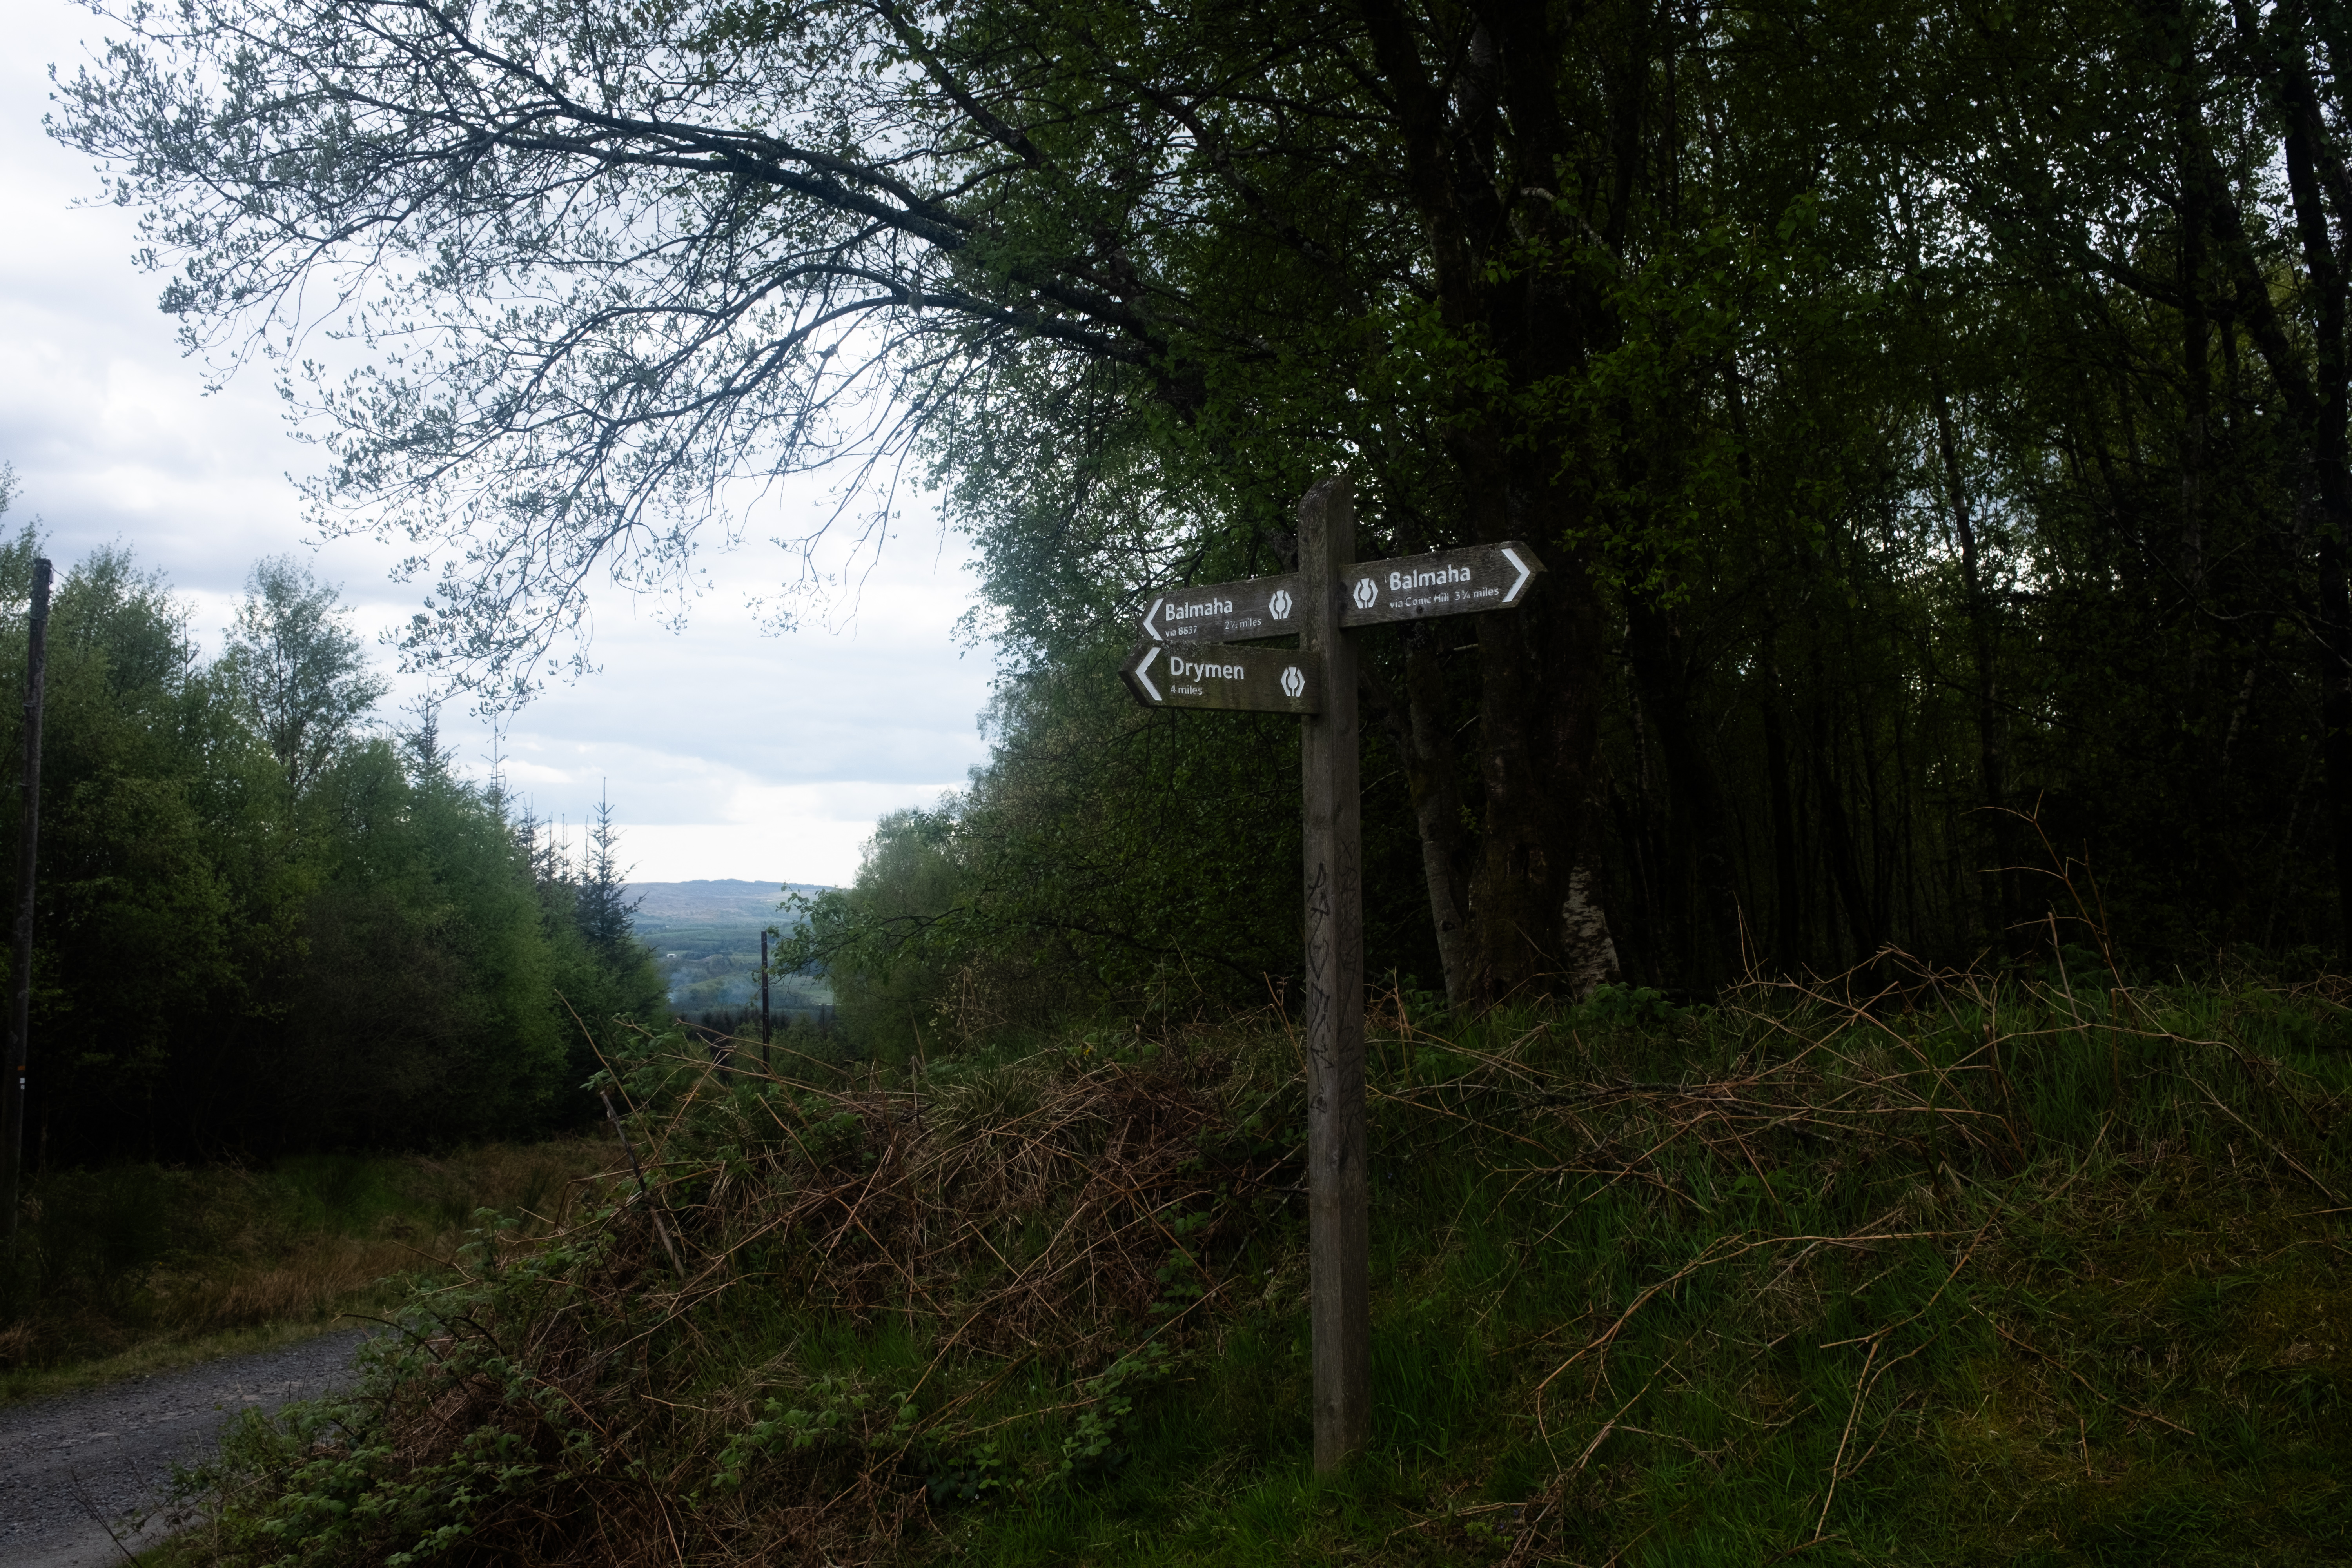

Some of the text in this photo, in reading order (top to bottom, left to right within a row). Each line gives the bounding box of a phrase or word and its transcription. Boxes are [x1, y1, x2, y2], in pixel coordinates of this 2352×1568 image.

[1390, 564, 1471, 591] Balmaha
[1389, 599, 1403, 608] via
[1405, 596, 1432, 606] Conic
[1434, 592, 1449, 603] Hill
[1473, 586, 1499, 598] miles
[1165, 597, 1232, 621] Balmaha
[1165, 628, 1177, 637] via
[1240, 617, 1261, 628] miles
[1171, 656, 1245, 682] Drymen
[1170, 684, 1203, 695] 4 miles
